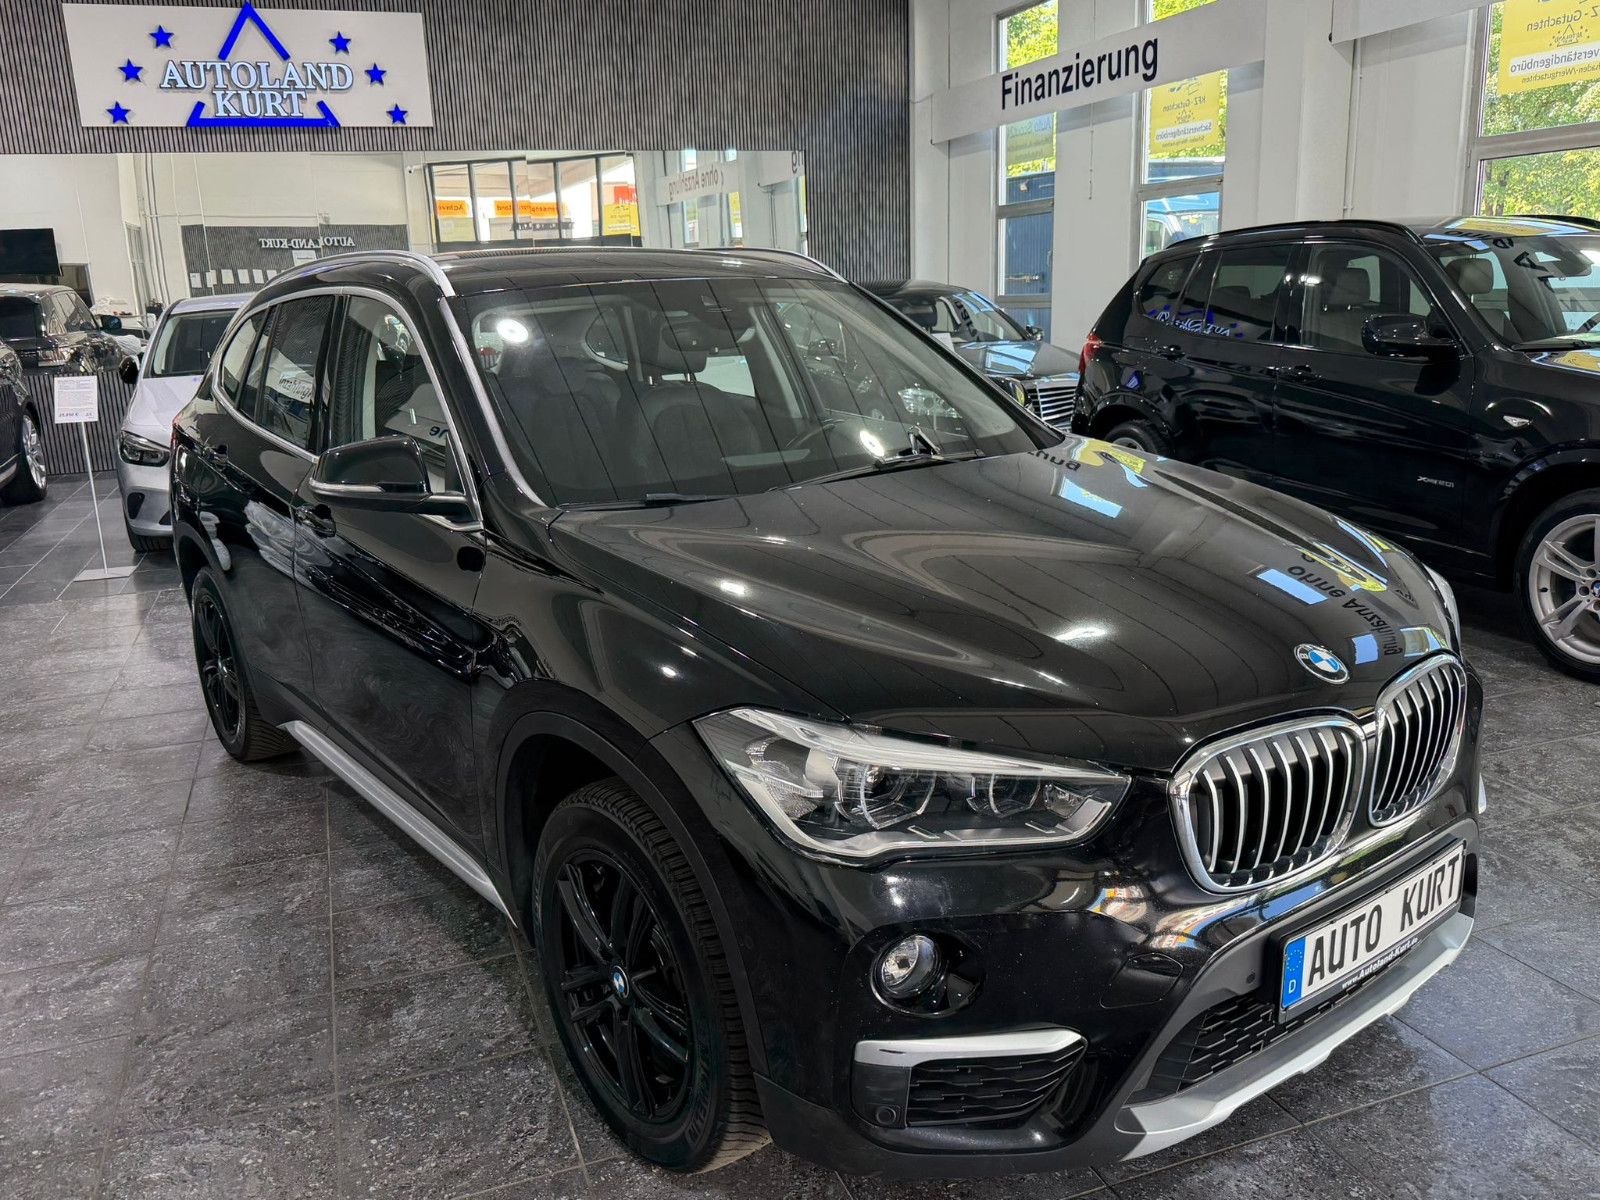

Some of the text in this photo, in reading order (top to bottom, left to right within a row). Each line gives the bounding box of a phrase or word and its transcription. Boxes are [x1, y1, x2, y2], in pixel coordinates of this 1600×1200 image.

[160, 60, 354, 91] AUTOLAND
[1001, 38, 1159, 110] Finanzierung
[214, 90, 306, 118] KURT
[1308, 852, 1461, 987] AUTO KURT
[1288, 979, 1296, 994] D
